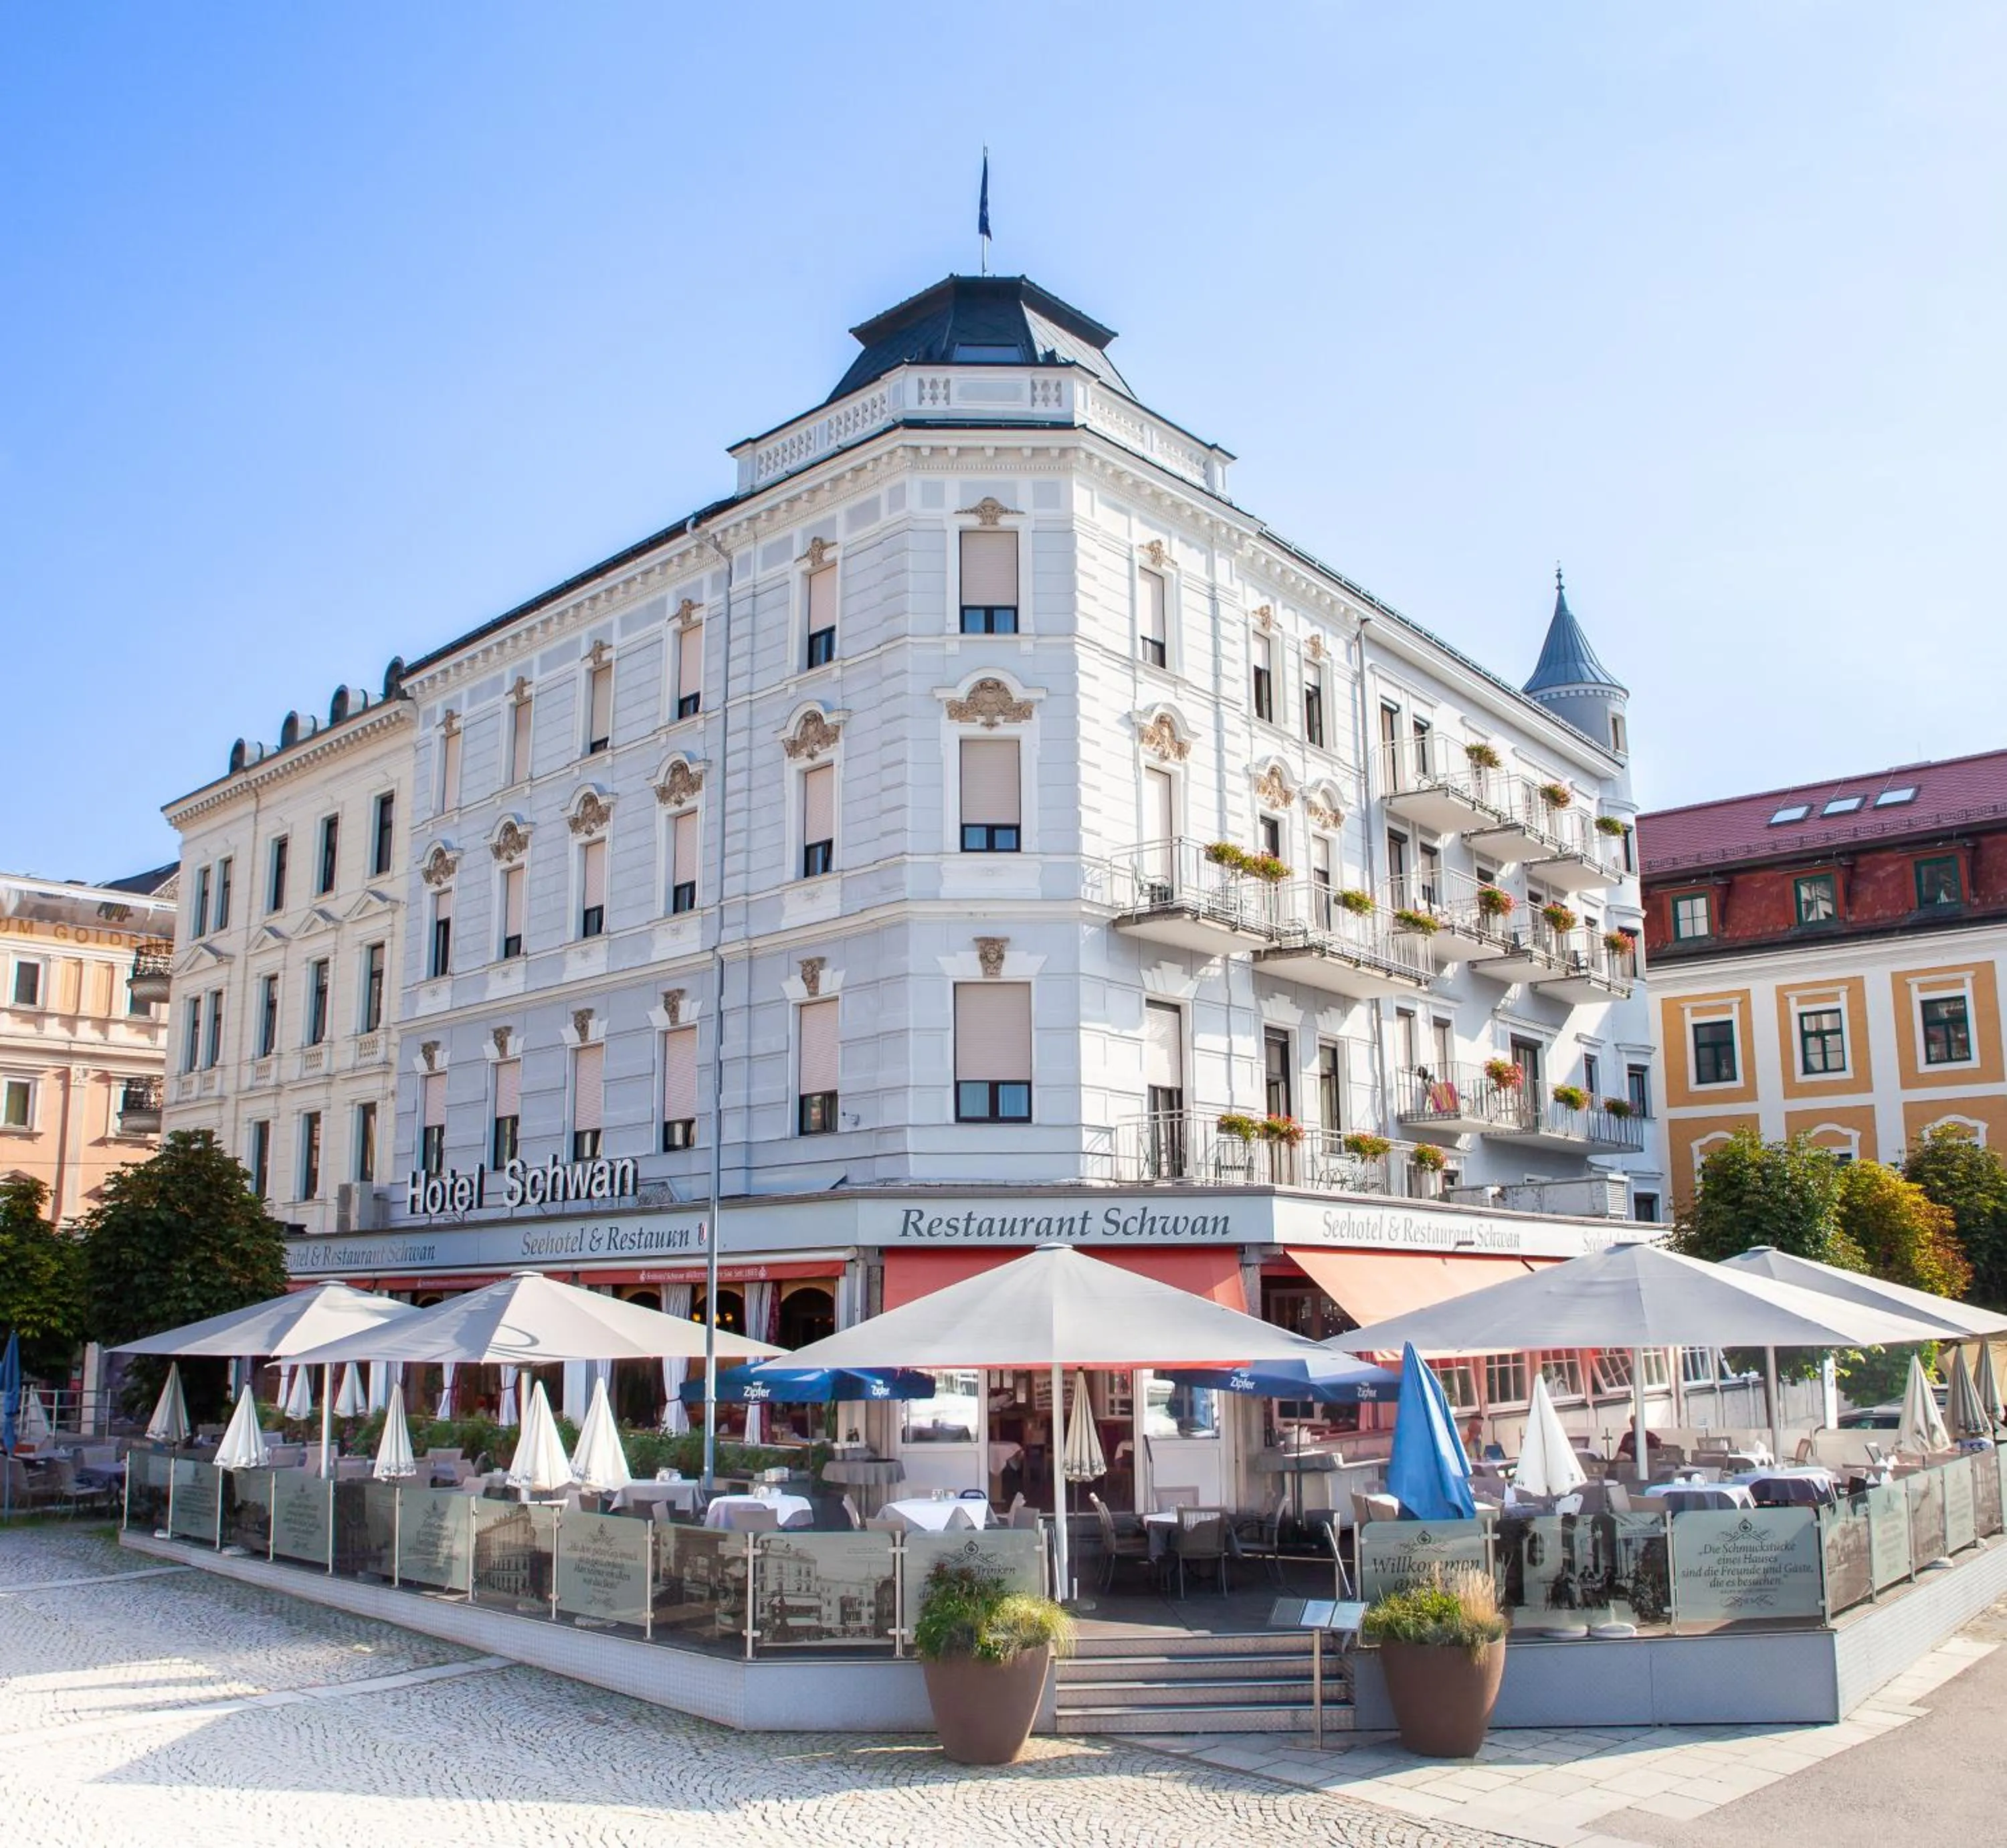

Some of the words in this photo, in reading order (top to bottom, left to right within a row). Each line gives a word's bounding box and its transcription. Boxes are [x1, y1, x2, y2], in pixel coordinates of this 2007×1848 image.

[407, 1163, 485, 1214] Hotel
[503, 1154, 638, 1207] Schwan
[898, 1208, 1092, 1238] Restaurant
[1102, 1206, 1231, 1236] Schwan
[1323, 1210, 1383, 1241] Seehotel
[1388, 1216, 1400, 1242] &
[1403, 1216, 1474, 1246] Restaurant
[1476, 1222, 1521, 1249] Schwan
[310, 1246, 320, 1267] &
[322, 1244, 384, 1267] Restaurant
[387, 1240, 436, 1264] Schwan
[522, 1227, 584, 1256] Seehotel
[589, 1226, 603, 1252] &
[743, 1385, 771, 1400] Zipfer
[1681, 1566, 1702, 1578] sind
[1704, 1566, 1719, 1576] die
[1721, 1564, 1761, 1576] Freunde
[1763, 1563, 1782, 1574] und
[1743, 1553, 1778, 1564] Hauses
[1709, 1577, 1724, 1588] die
[1725, 1579, 1736, 1587] es
